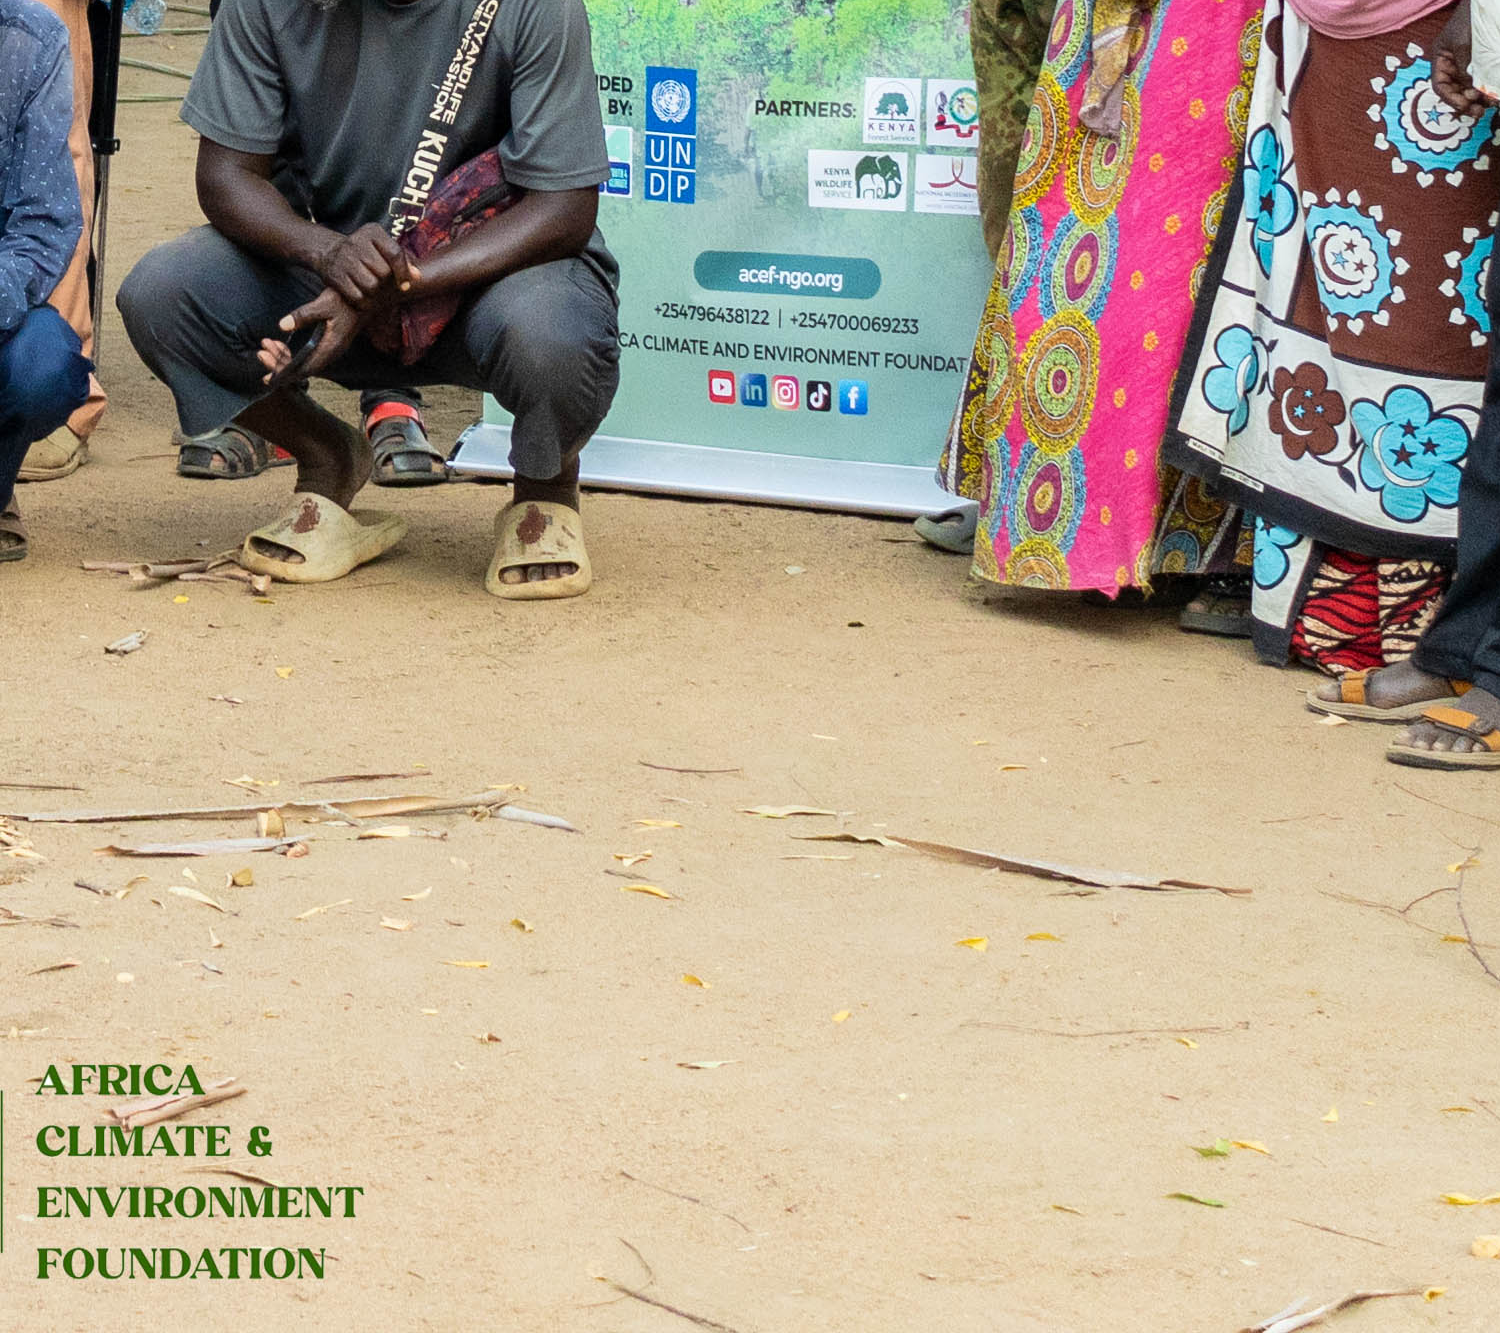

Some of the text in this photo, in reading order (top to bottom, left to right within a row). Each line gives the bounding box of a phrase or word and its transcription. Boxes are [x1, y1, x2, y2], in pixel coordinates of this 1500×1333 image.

[608, 98, 633, 116] BY:
[754, 99, 857, 119] PARTNERS:
[868, 122, 915, 132] KENYA
[823, 167, 851, 176] KENYA
[814, 179, 853, 189] WILDLIFE
[823, 190, 853, 199] SERVICE
[738, 265, 844, 292] acef-ngo.org
[653, 303, 920, 335] +254796438122 +254700069233
[642, 334, 709, 356] CLIMATE
[712, 341, 750, 359] AND
[753, 345, 881, 368] ENVIRONMENT
[884, 352, 967, 374] FOUNDAT
